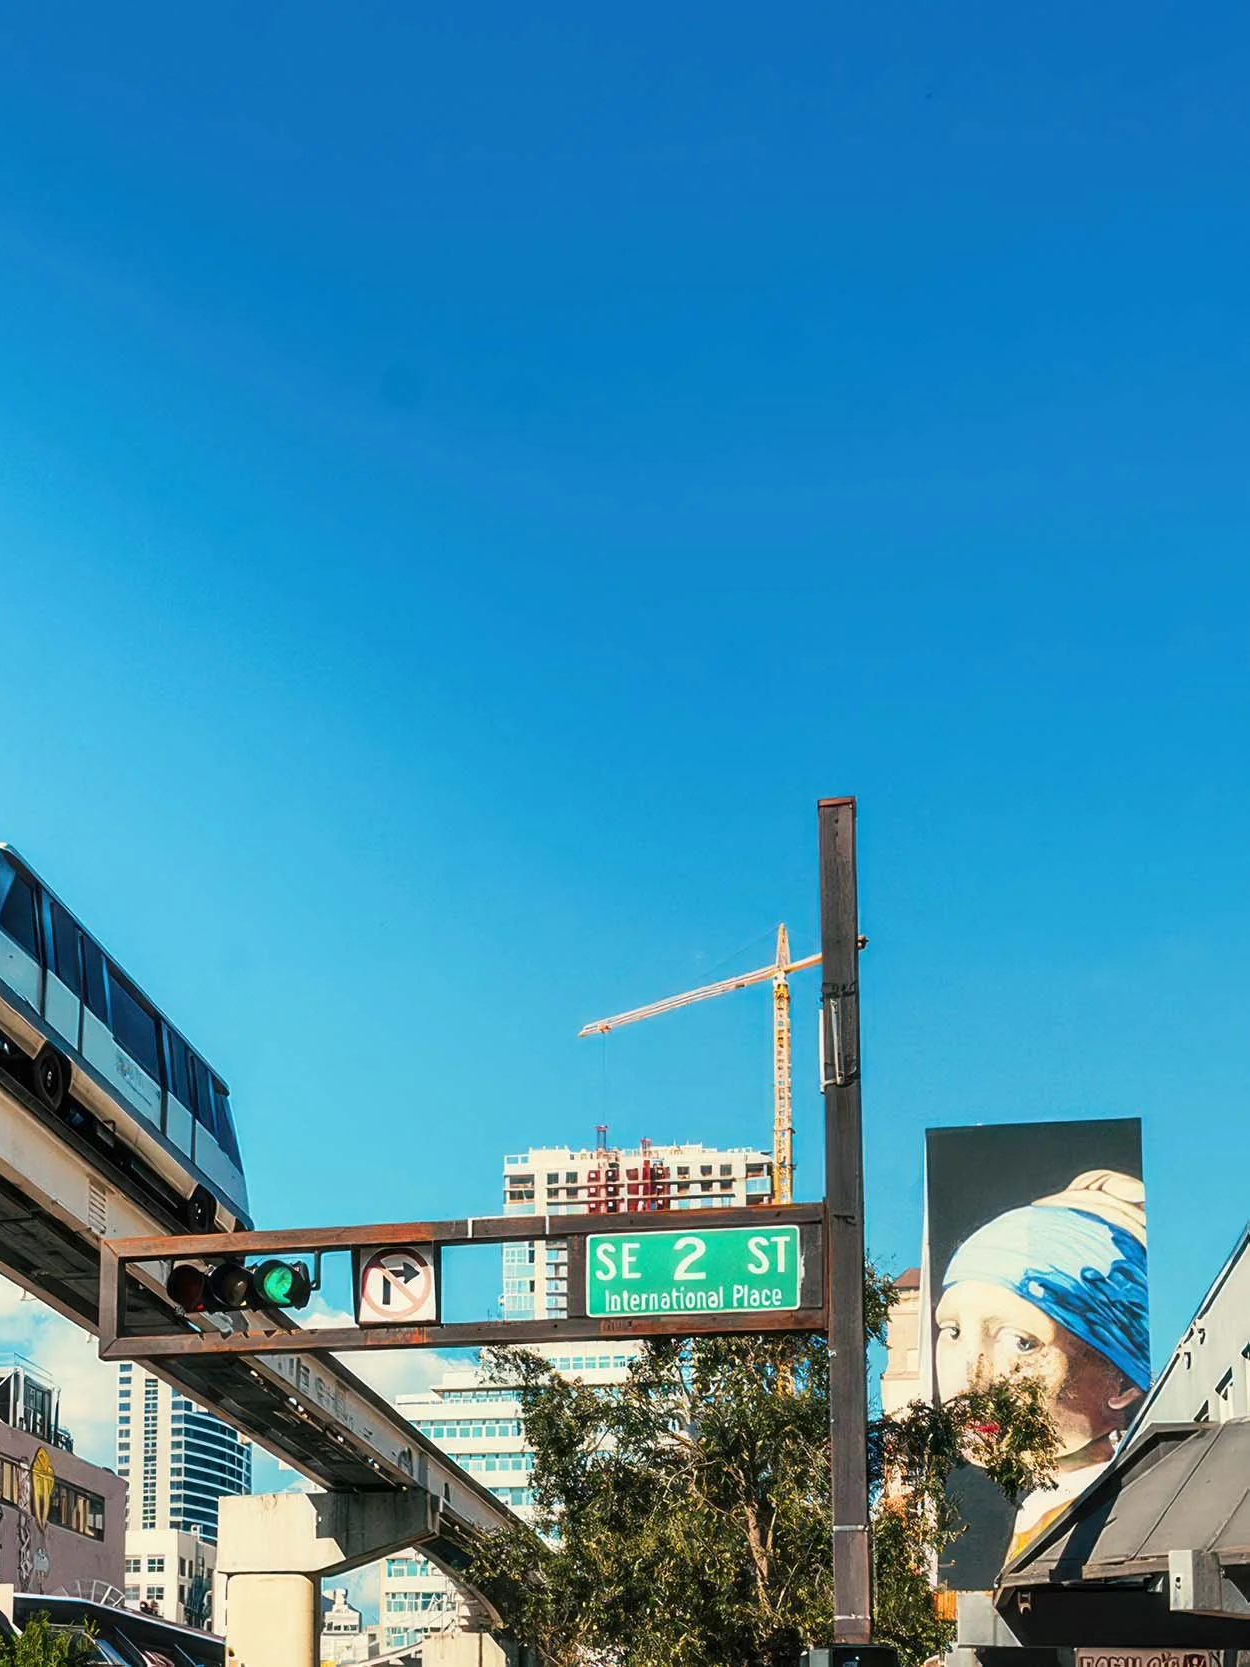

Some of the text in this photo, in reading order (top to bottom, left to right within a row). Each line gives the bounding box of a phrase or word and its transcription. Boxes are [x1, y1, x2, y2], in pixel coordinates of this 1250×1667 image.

[595, 1235, 791, 1282] SE 2 ST
[605, 1284, 783, 1312] International Place
